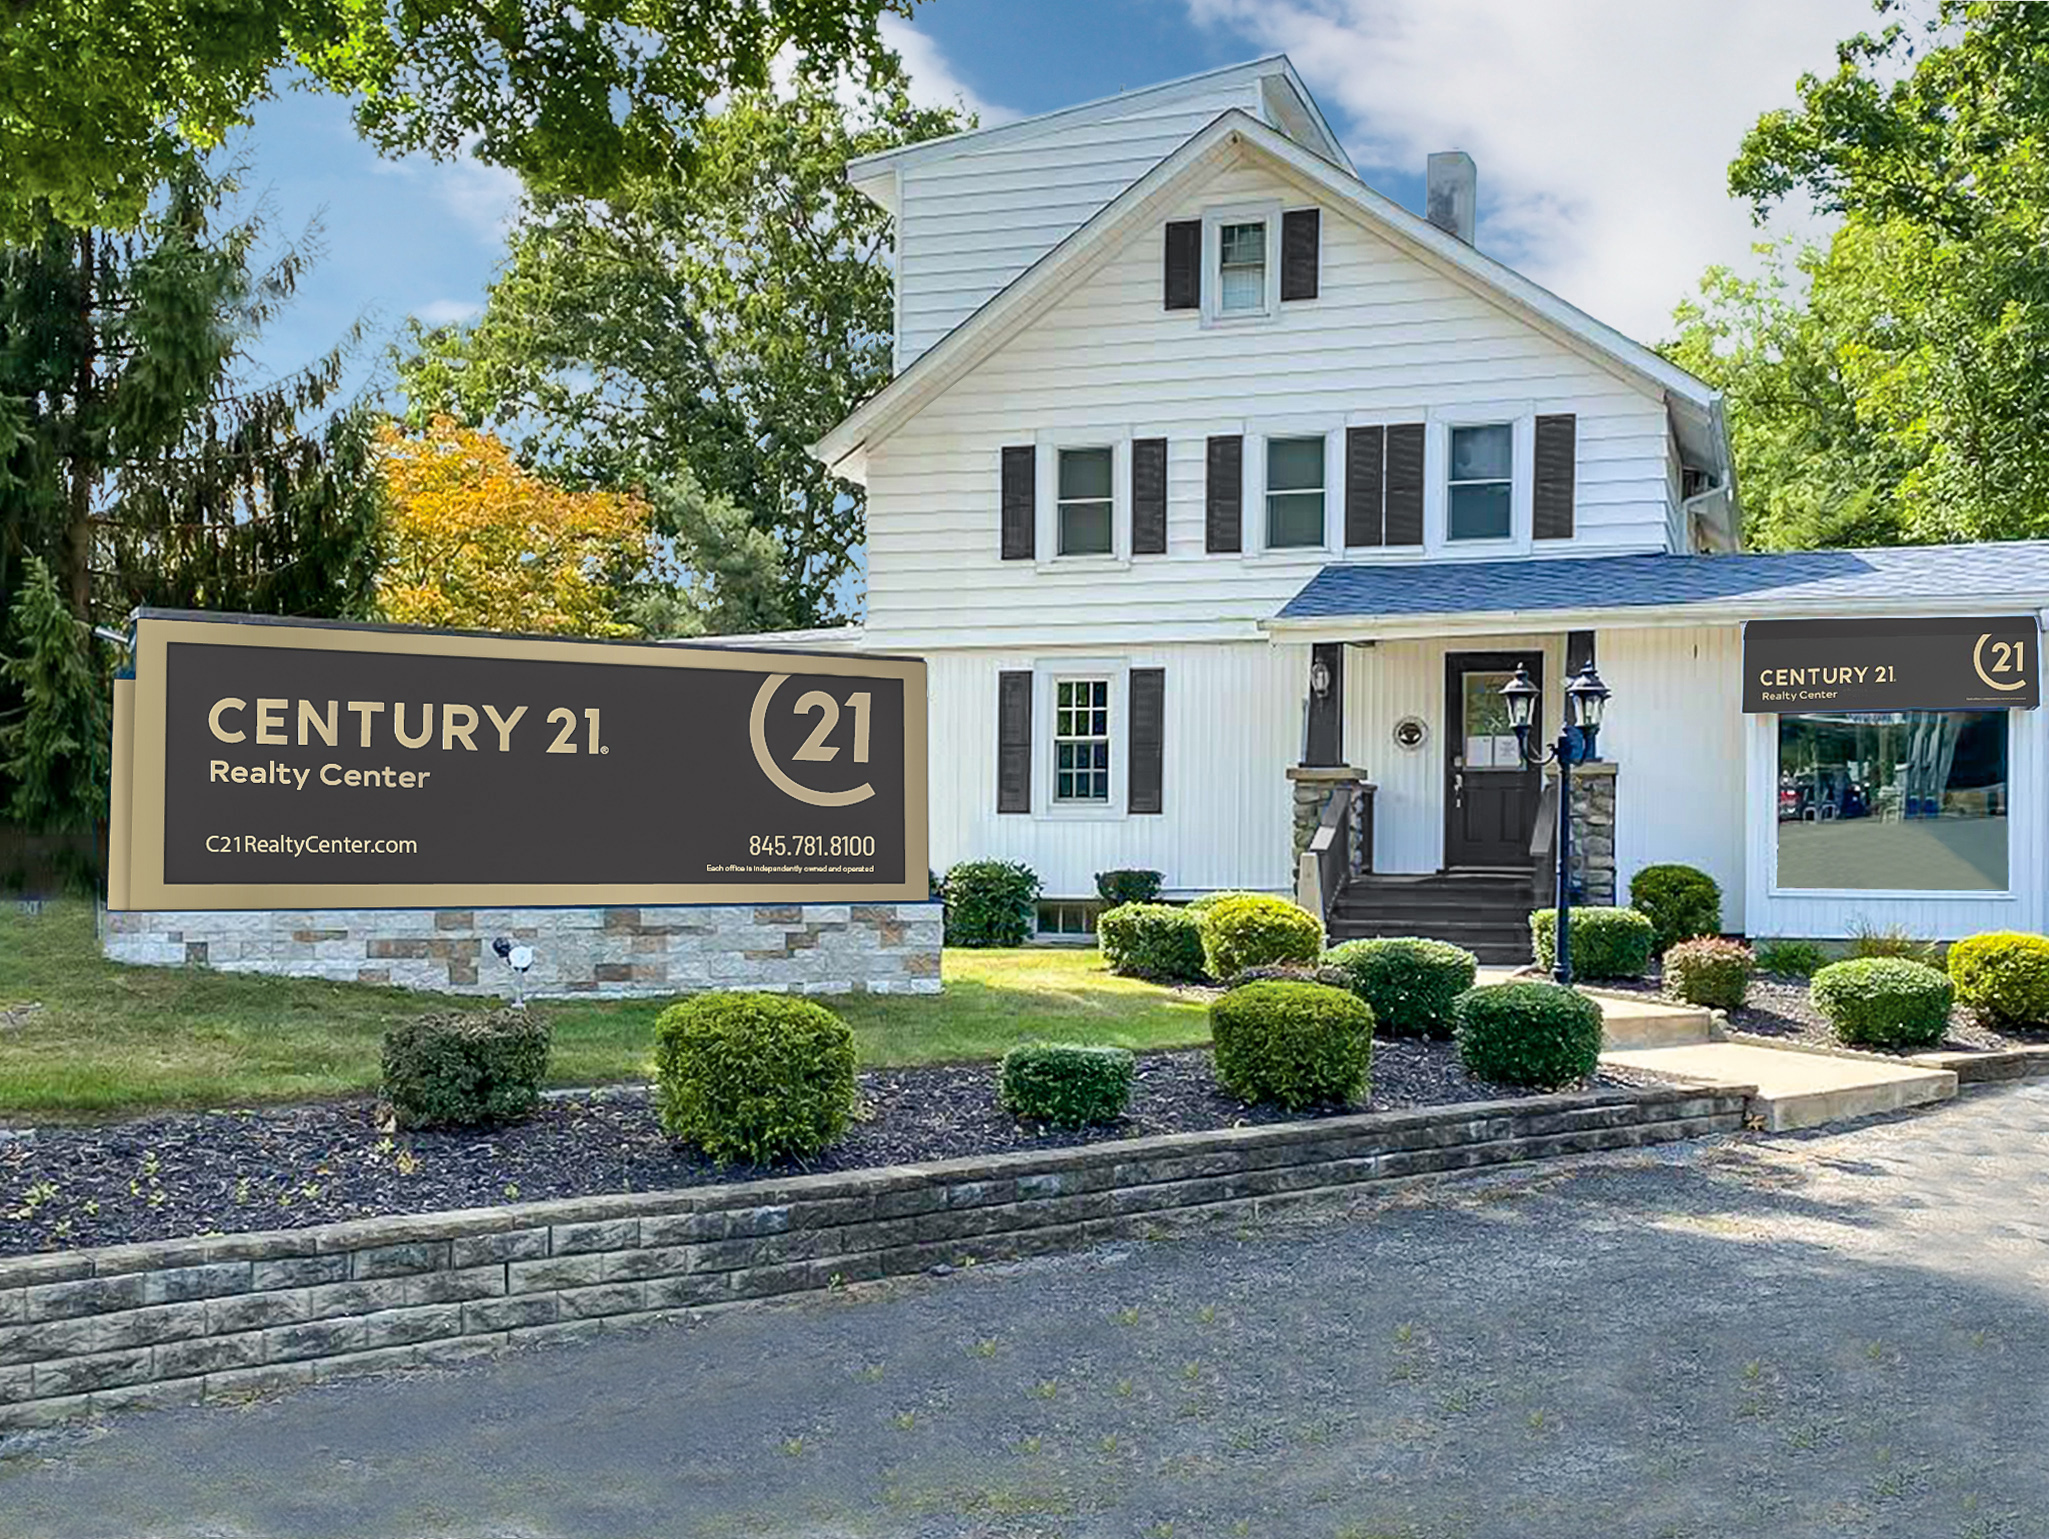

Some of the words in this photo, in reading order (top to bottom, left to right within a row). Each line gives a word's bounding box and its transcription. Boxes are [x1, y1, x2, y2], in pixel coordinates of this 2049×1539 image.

[1759, 665, 1869, 687] CENTURY
[1761, 692, 1798, 702] Realty
[1799, 690, 1839, 700] Center
[207, 697, 529, 752] CENTURY
[210, 759, 311, 791] Realty
[319, 763, 431, 789] Center
[205, 834, 418, 858] C21RealtyCenter.com
[748, 834, 876, 857] 845.781.8100
[706, 863, 724, 873] Each
[724, 863, 746, 873] office
[753, 864, 803, 875] independently
[803, 864, 828, 873] owned
[828, 864, 842, 873] and
[842, 864, 875, 875] operated
